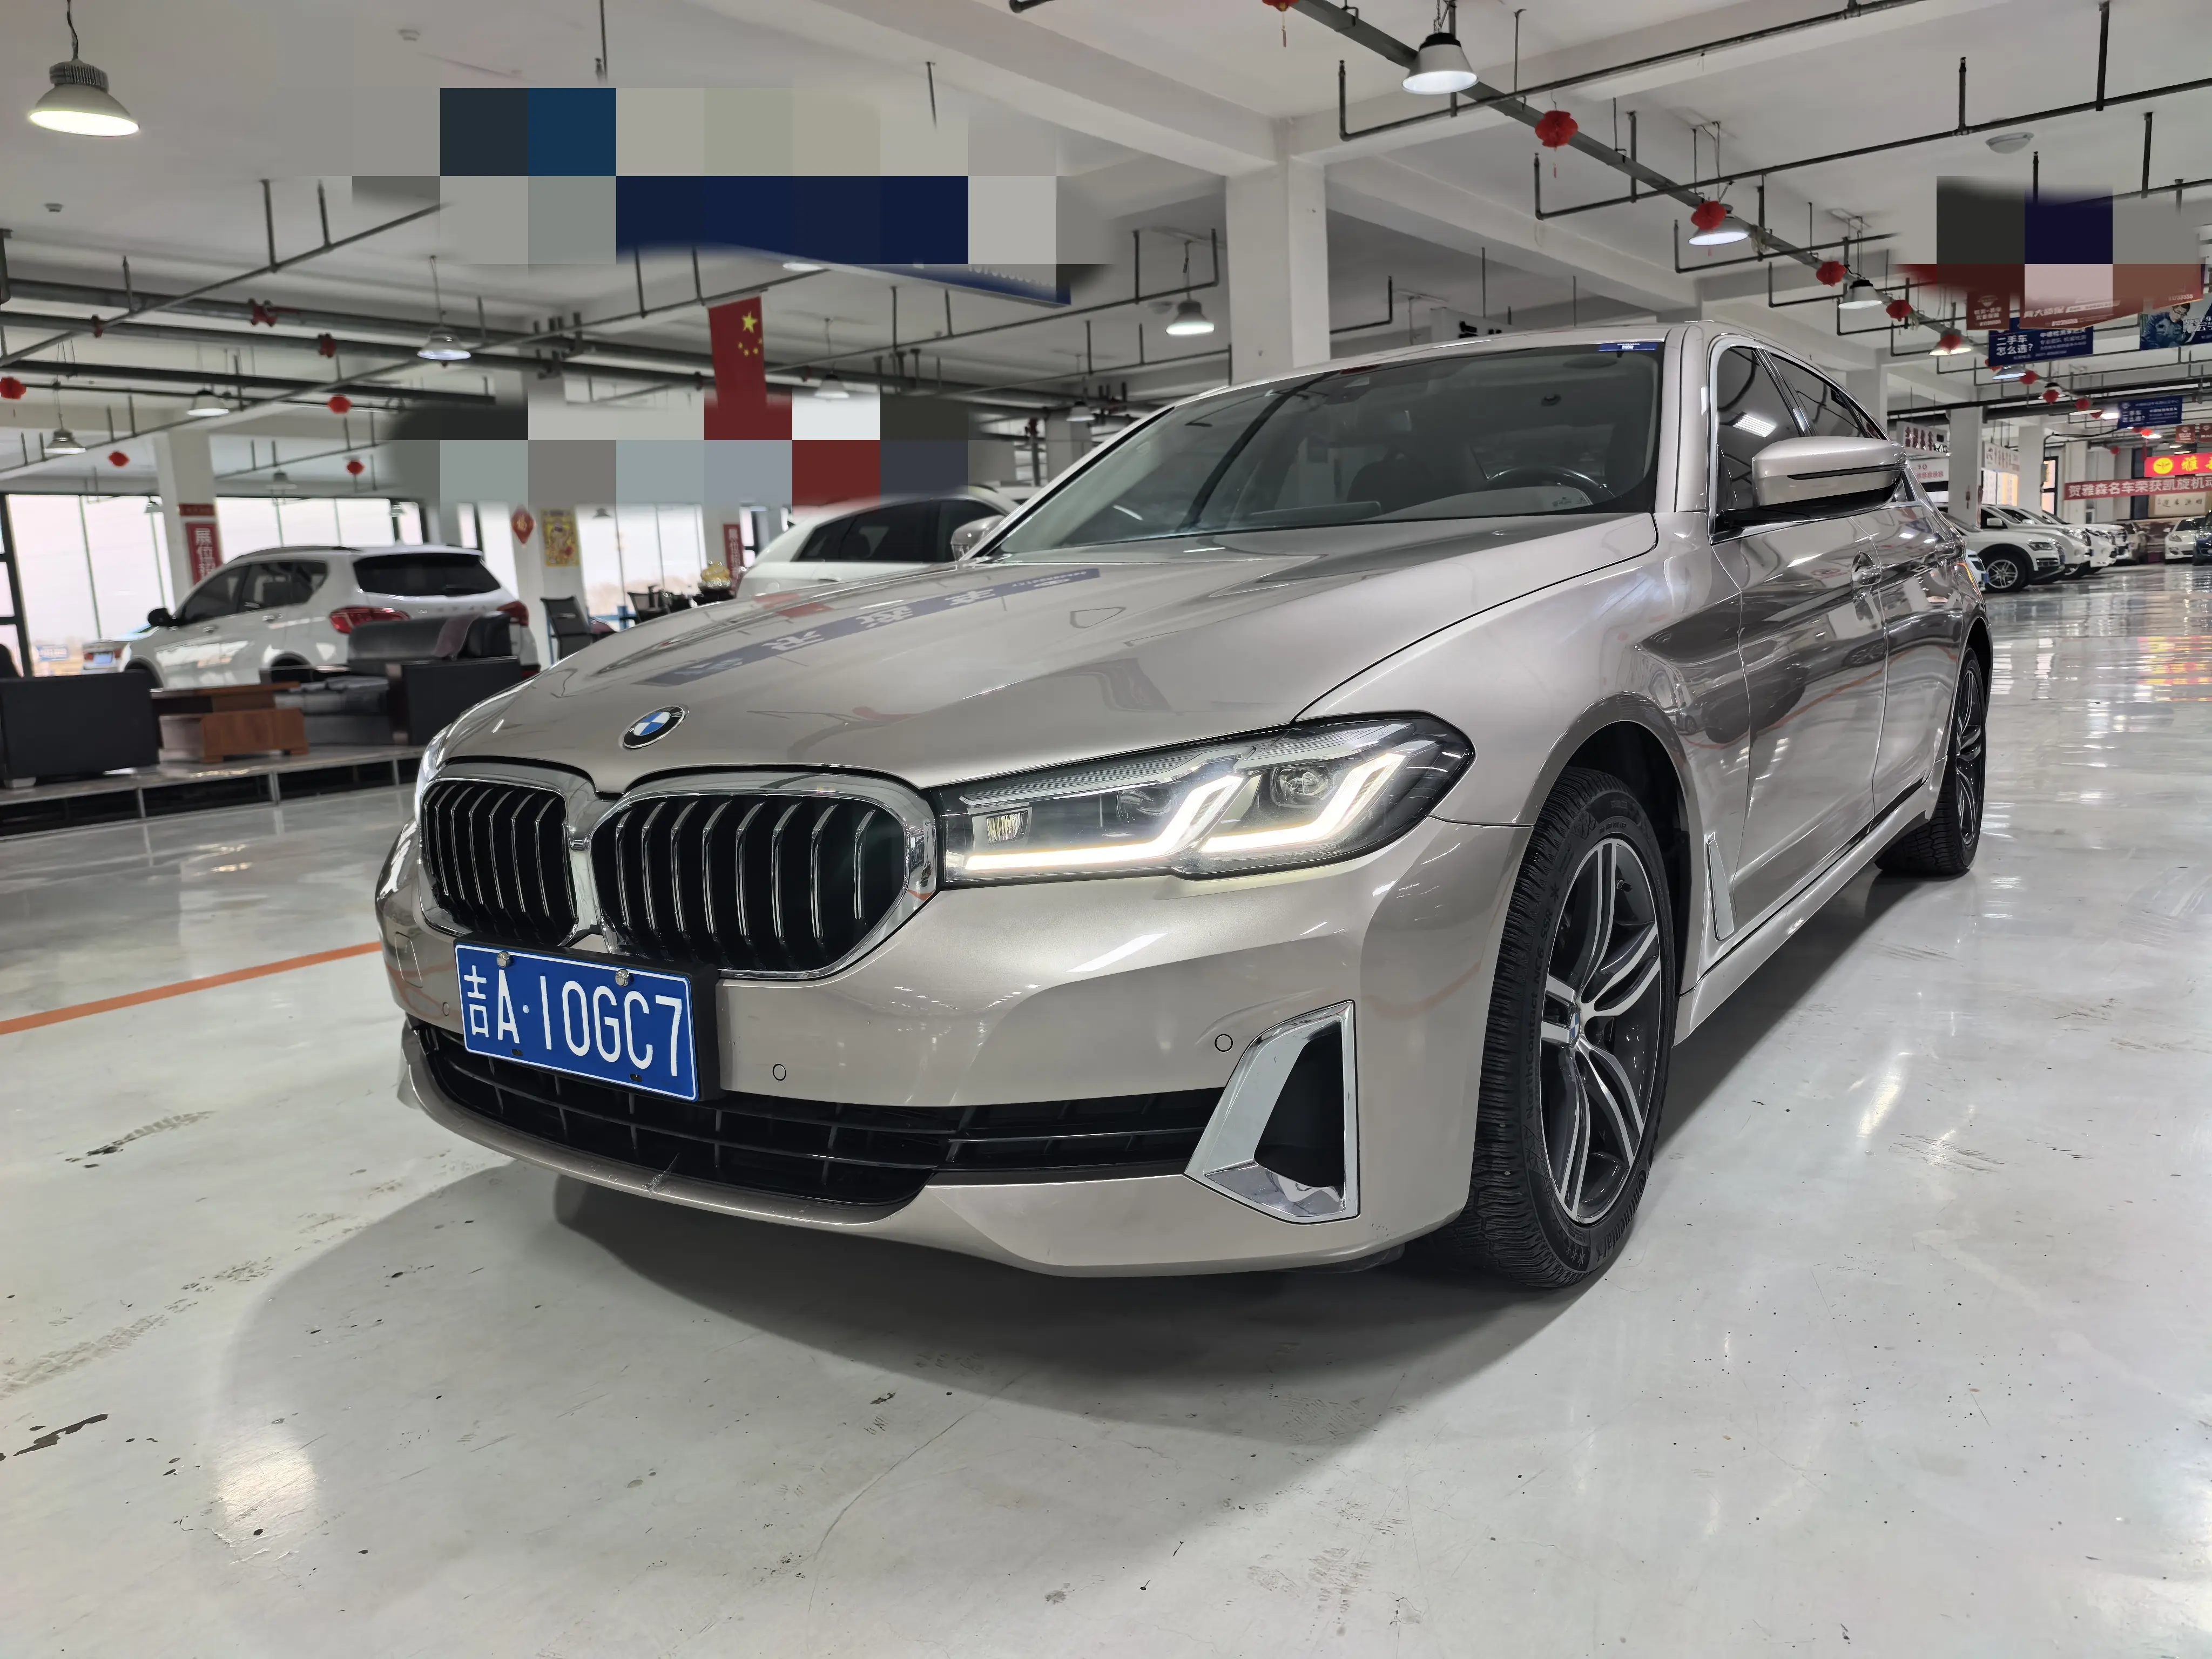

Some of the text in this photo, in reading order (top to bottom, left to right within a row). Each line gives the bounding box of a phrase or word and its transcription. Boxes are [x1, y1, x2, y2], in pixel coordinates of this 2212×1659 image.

[1997, 334, 2028, 346] 二手车
[1378, 729, 1389, 737] LED
[1526, 992, 1538, 1120] NorthContact
[1541, 908, 1553, 941] SSR
